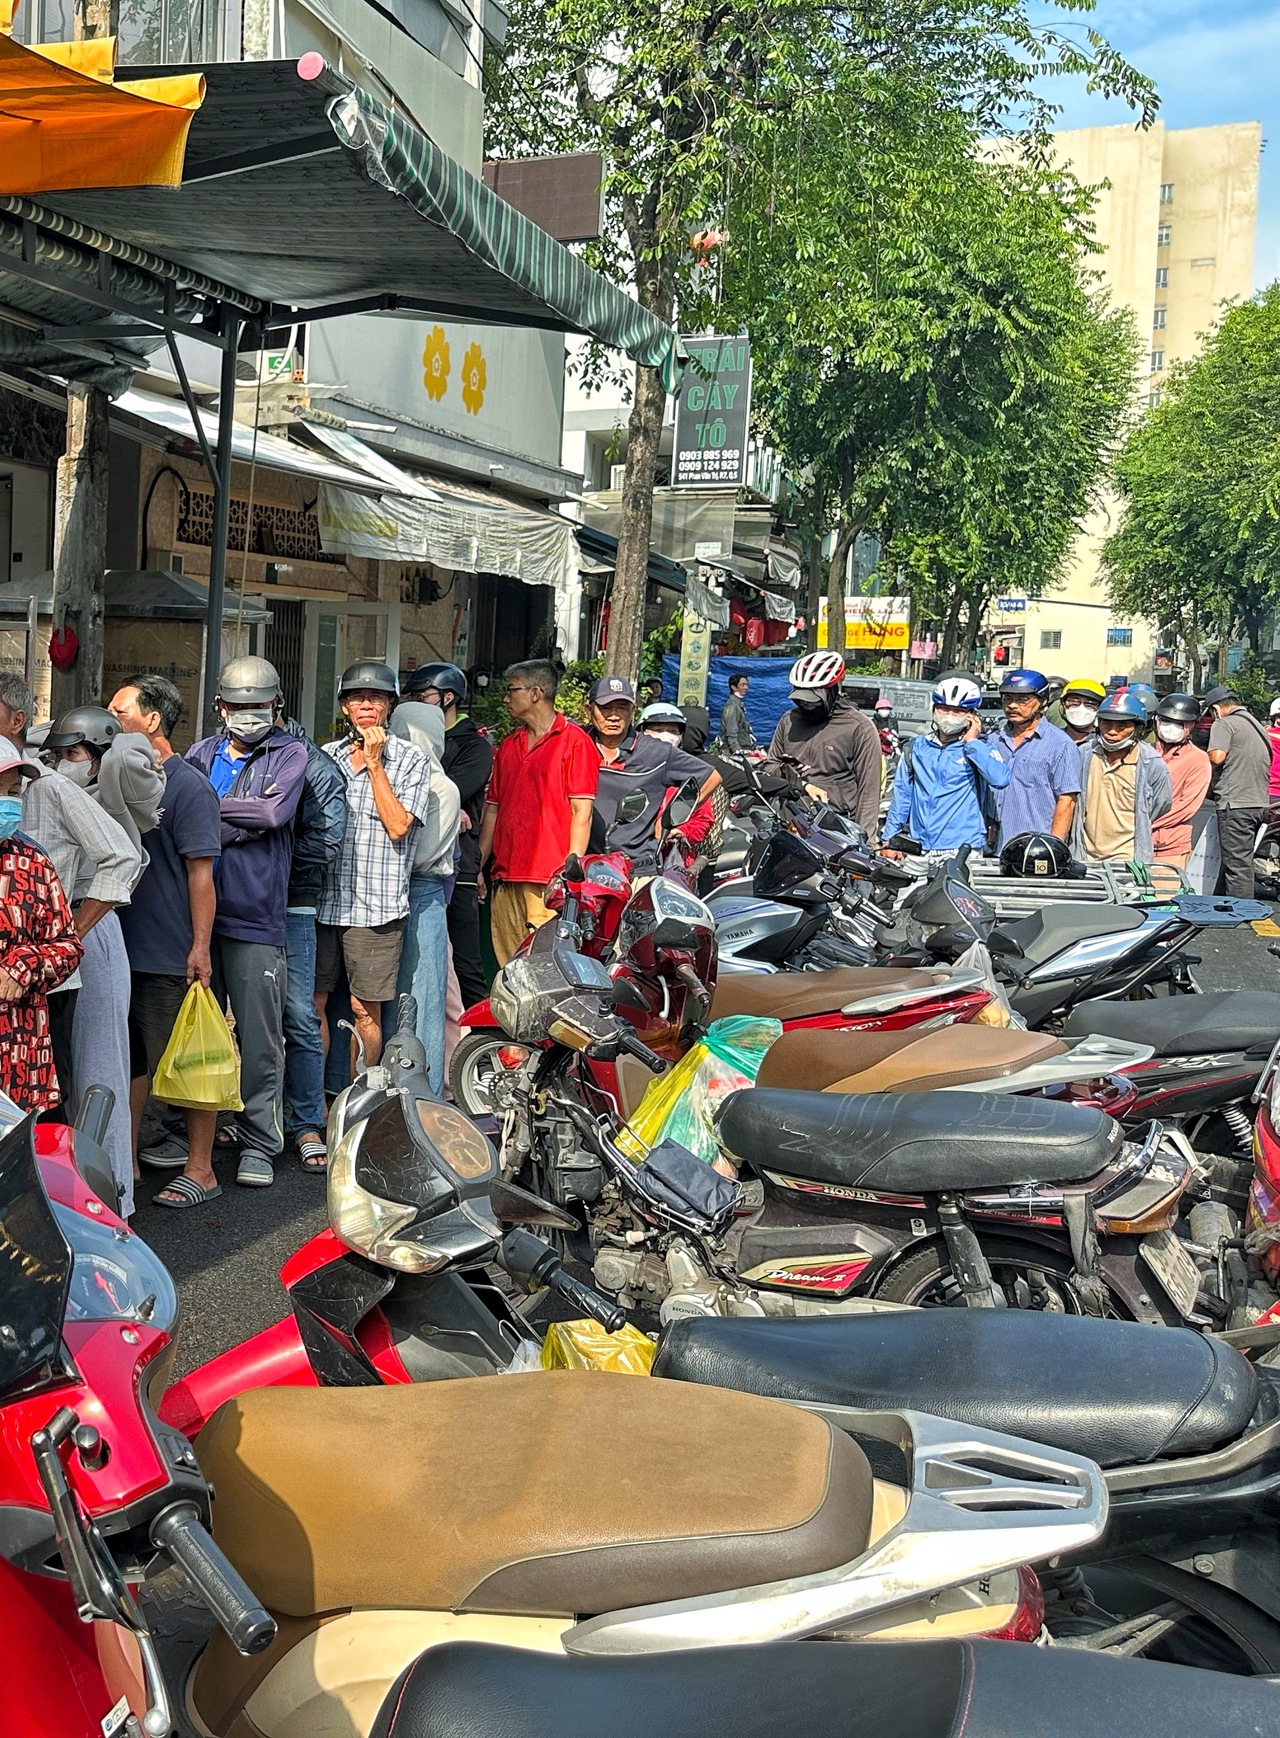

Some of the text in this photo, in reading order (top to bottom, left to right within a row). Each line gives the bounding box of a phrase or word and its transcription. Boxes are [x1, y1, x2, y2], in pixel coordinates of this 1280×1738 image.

[688, 342, 745, 373] TRÁI
[687, 380, 740, 411] CÂY
[695, 418, 727, 448] TÔ
[679, 449, 739, 460] 0903 885 969
[678, 460, 739, 471] 0909 124 929
[103, 663, 147, 674] WASHING
[725, 929, 754, 940] YAMAHA
[823, 1186, 878, 1200] HONDA
[764, 1269, 846, 1282] Dream II
[672, 1307, 703, 1316] HONDA
